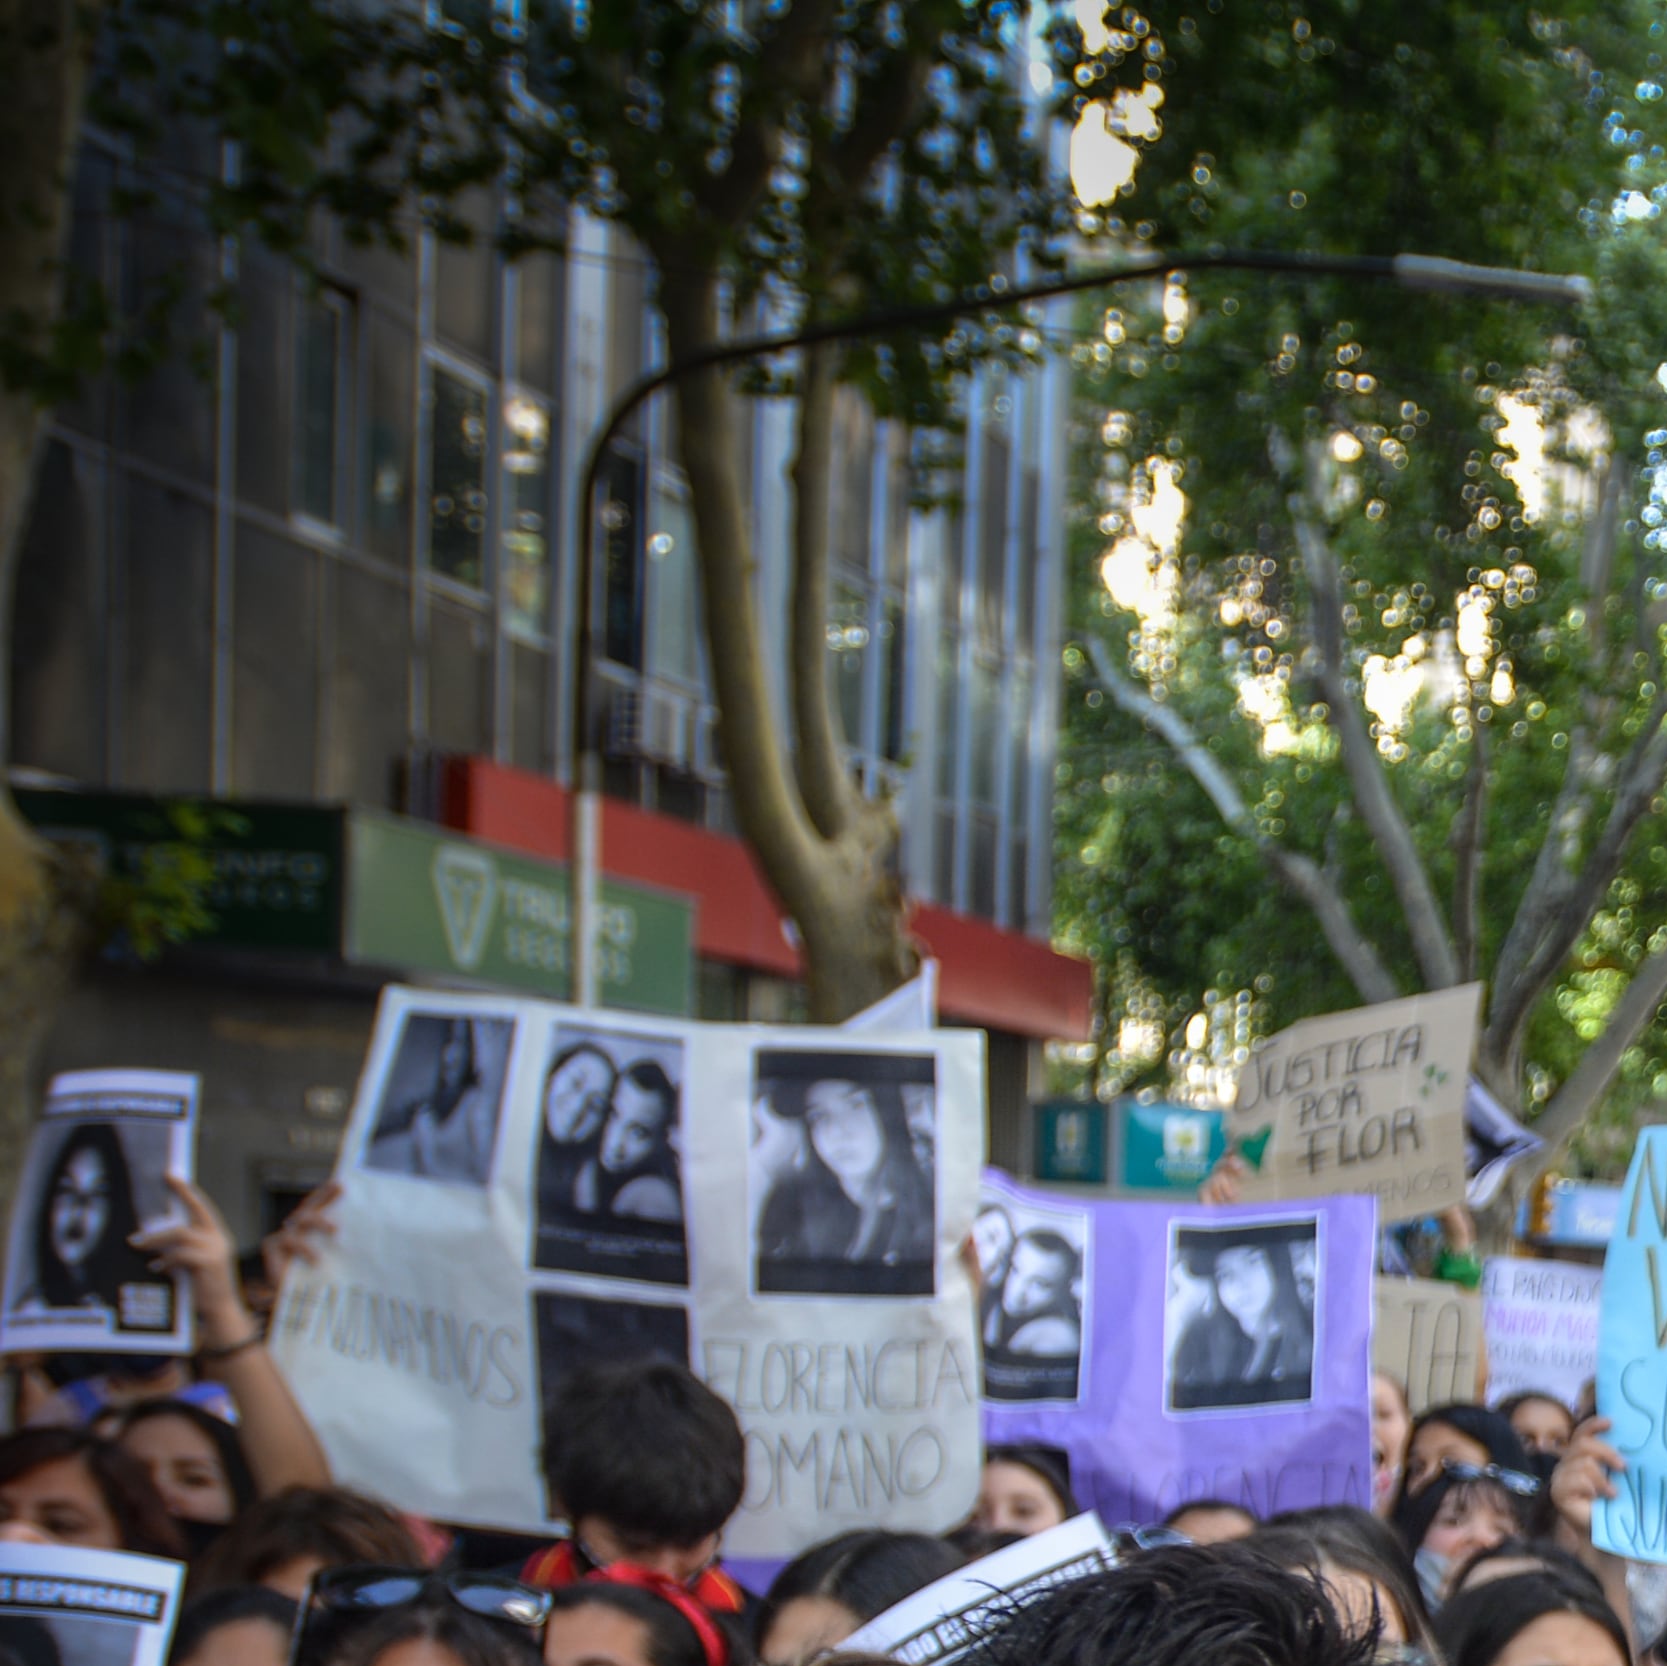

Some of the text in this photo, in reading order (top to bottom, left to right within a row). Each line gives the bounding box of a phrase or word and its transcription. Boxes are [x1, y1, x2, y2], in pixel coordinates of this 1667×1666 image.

[1235, 1022, 1424, 1117] JUSTICIA
[1293, 1079, 1362, 1127] POR
[1297, 1106, 1426, 1174] FLOR
[702, 1337, 973, 1416] FLORENCIA
[743, 1424, 949, 1513] OMANO
